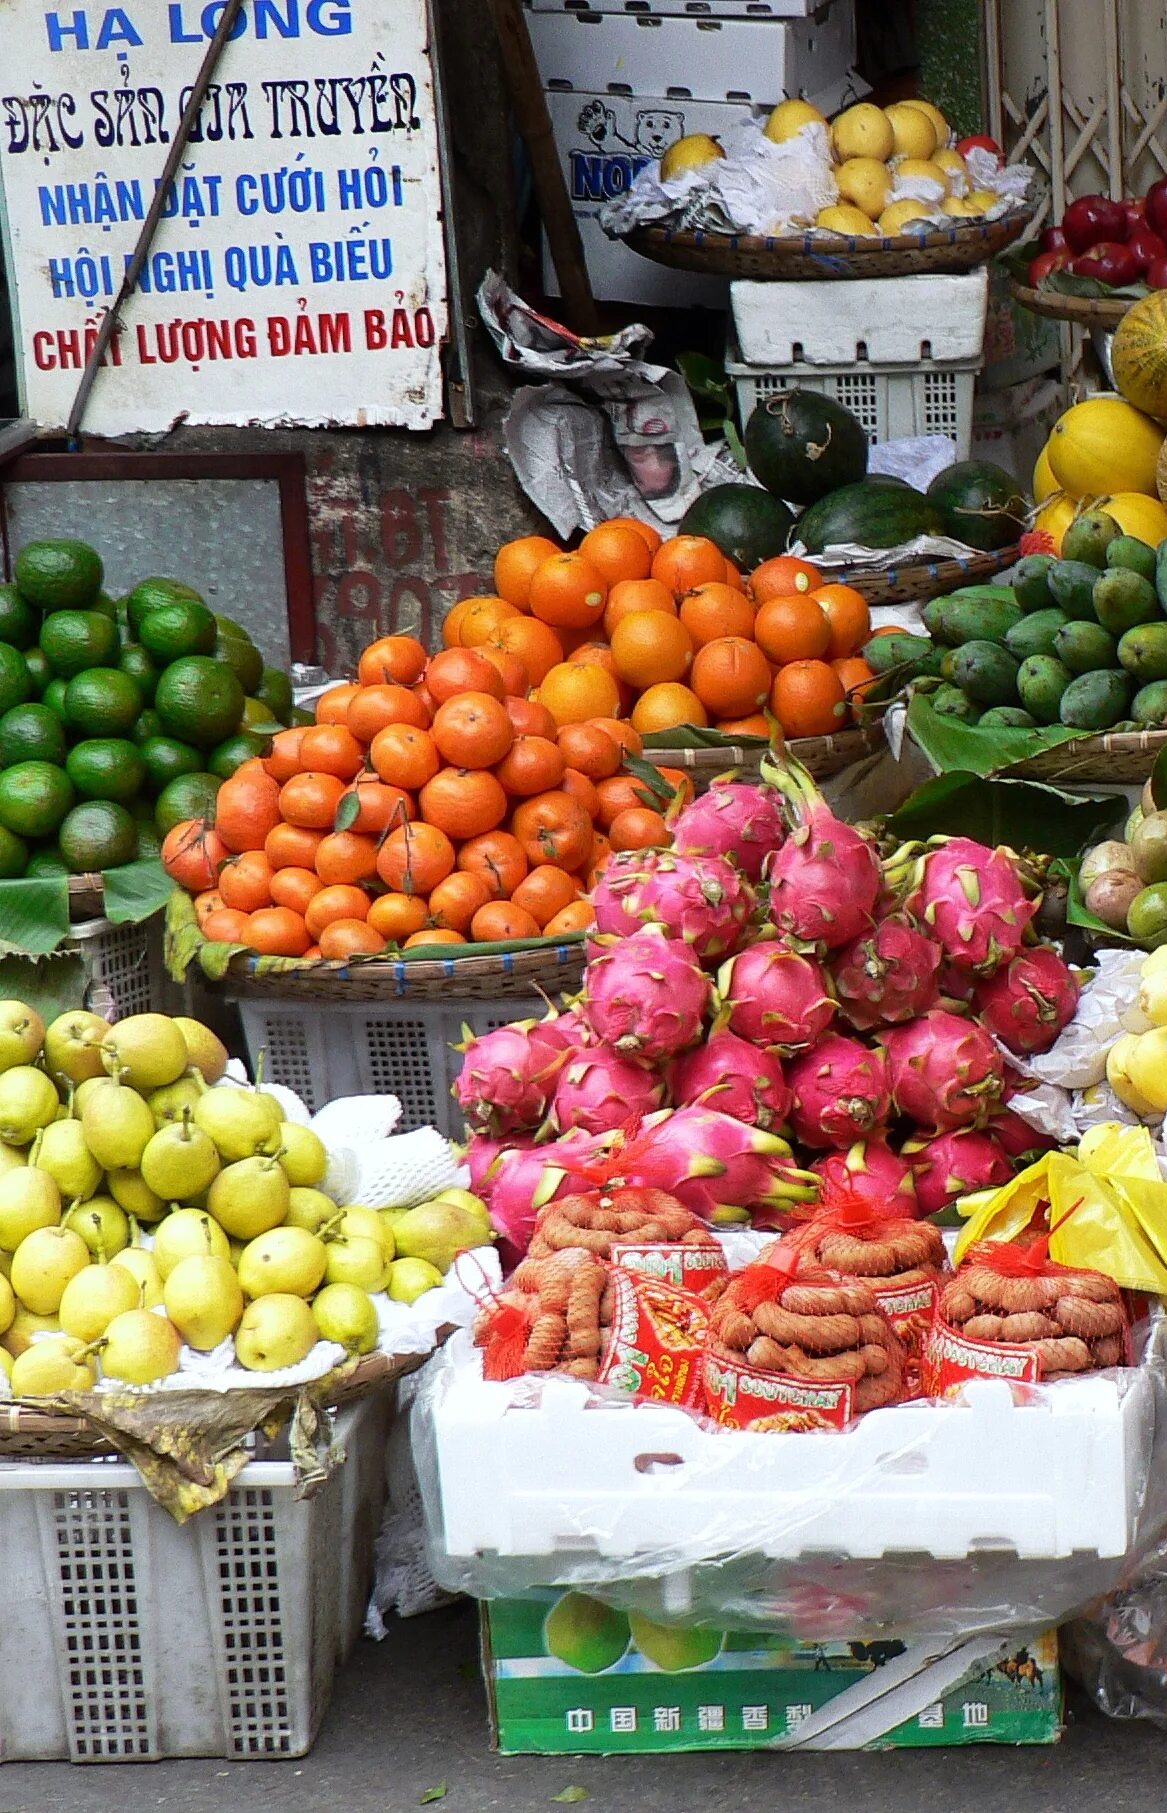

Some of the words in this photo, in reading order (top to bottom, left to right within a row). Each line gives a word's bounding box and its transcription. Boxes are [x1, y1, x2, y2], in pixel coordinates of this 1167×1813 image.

[45, 8, 144, 61] HẠ
[168, 0, 352, 43] LONG
[3, 80, 84, 166] ĐẶC
[90, 64, 170, 147] SẢN
[261, 52, 420, 139] TRUYỀN
[38, 172, 145, 231] NHẬN
[236, 152, 325, 216] CƯỚI
[338, 147, 403, 210] HỎI
[49, 247, 113, 307] HỘI
[225, 232, 298, 292] QUÀ
[309, 221, 393, 284] BIẾU
[137, 318, 257, 372] LƯỢNG
[267, 297, 351, 357] ĐẢM
[364, 290, 435, 350] BẢO
[565, 1701, 989, 1734] 中国新疆香梨基地
